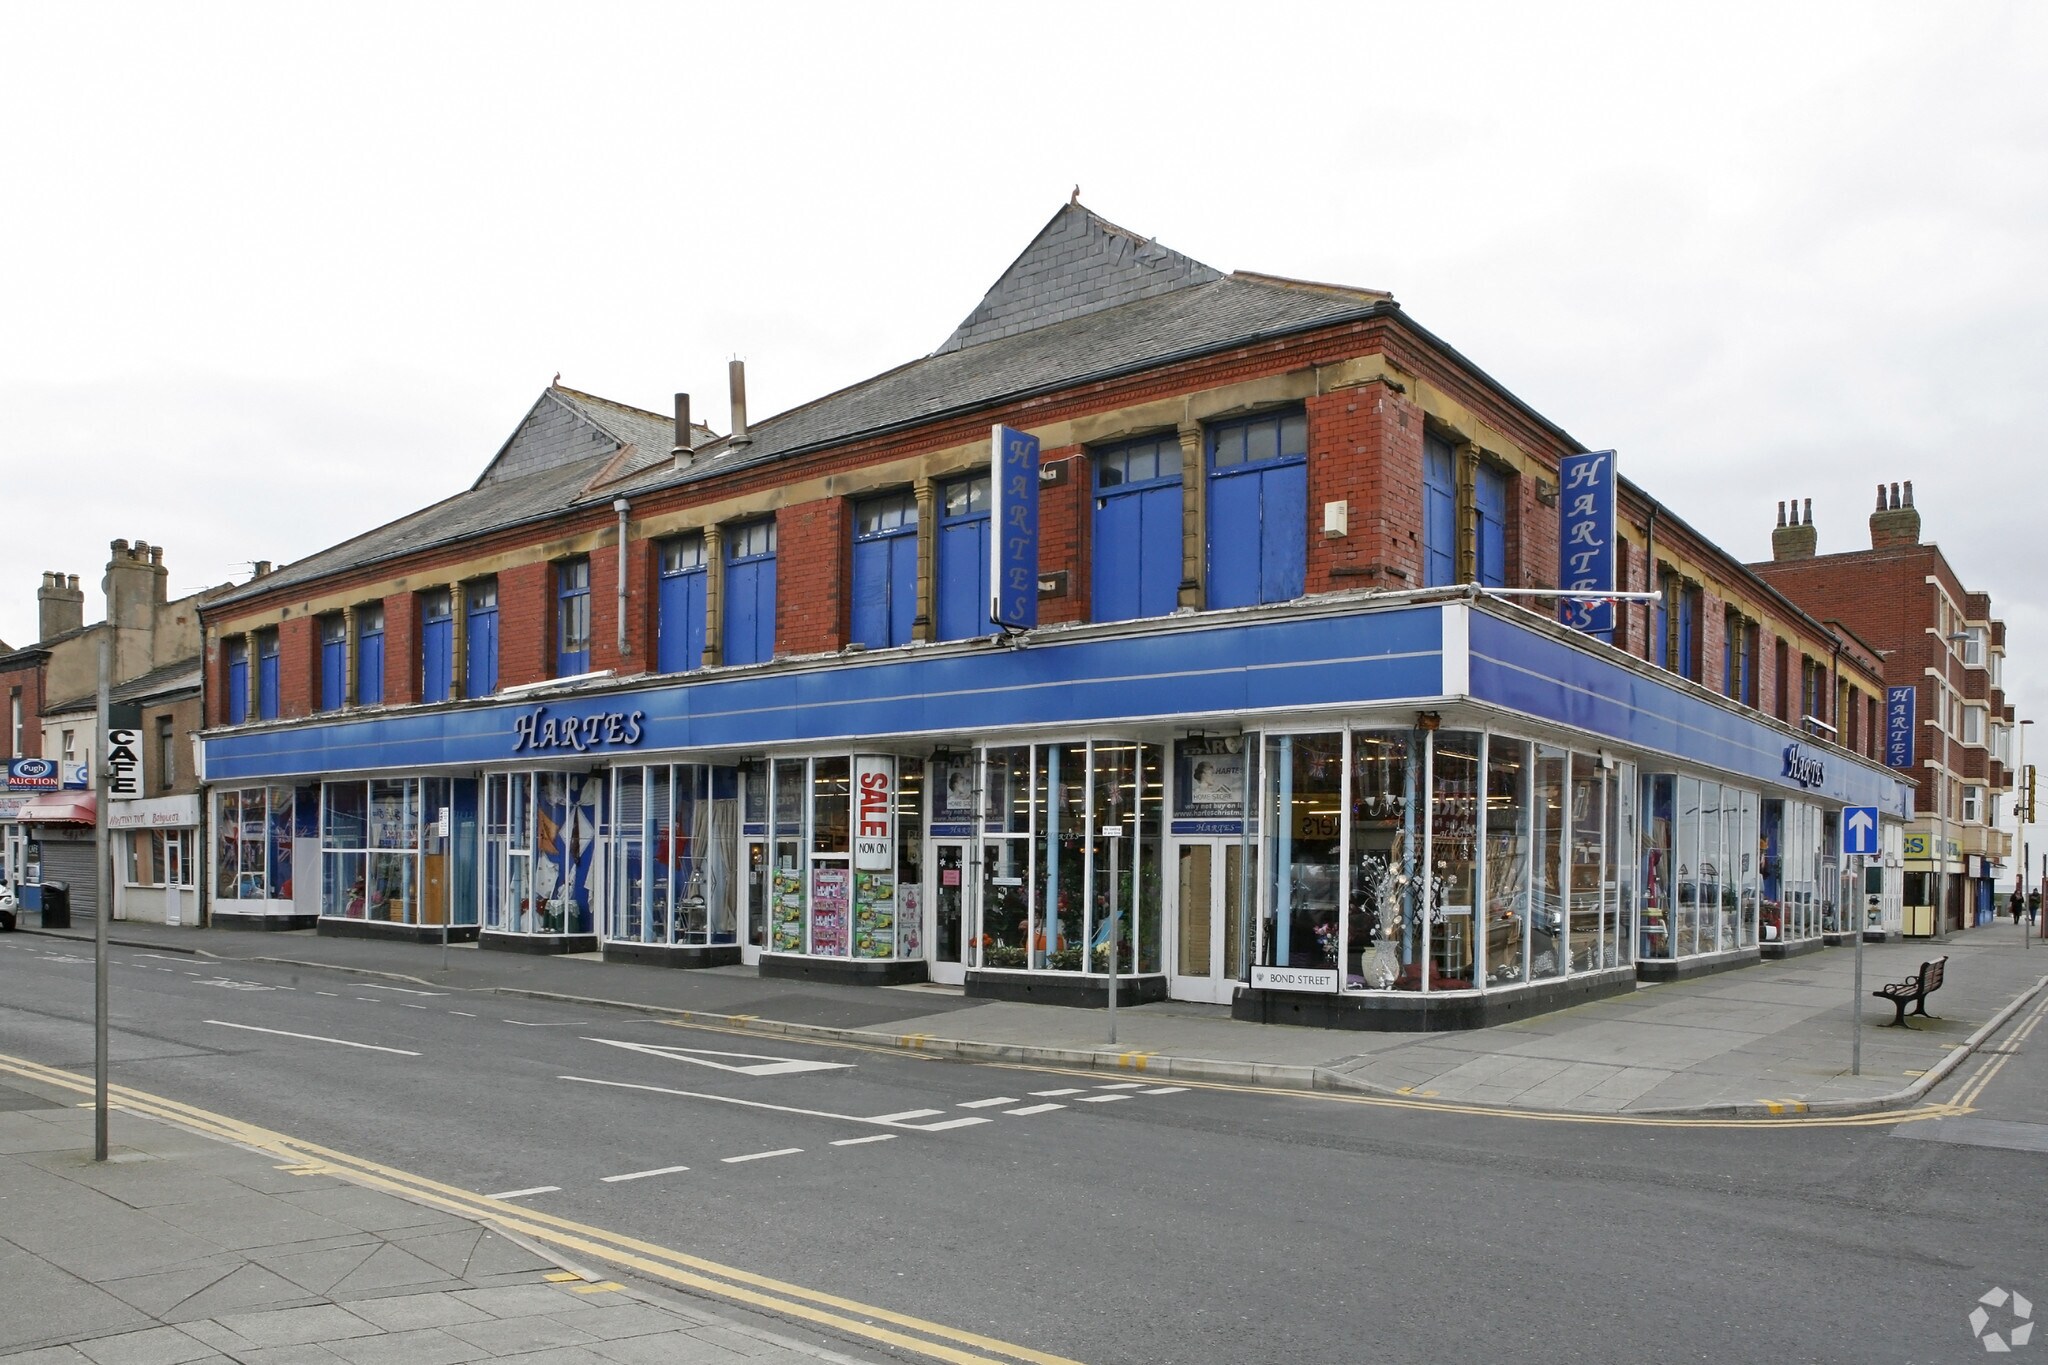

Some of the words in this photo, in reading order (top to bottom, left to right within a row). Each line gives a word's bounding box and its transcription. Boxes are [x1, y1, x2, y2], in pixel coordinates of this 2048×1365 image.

[1008, 440, 1034, 620] HARTES
[1566, 456, 1606, 630] HARTES
[512, 707, 645, 751] HARTES
[1890, 688, 1911, 766] HARTES
[24, 764, 44, 773] Pugh
[108, 730, 138, 793] CAFE
[9, 777, 58, 786] AUCTION
[859, 773, 888, 836] SALE
[1213, 802, 1225, 810] buy
[1195, 822, 1236, 833] HARTES
[859, 843, 876, 854] NOW
[877, 843, 888, 854] ON
[1270, 973, 1295, 984] BOND
[1297, 975, 1331, 985] STREET
